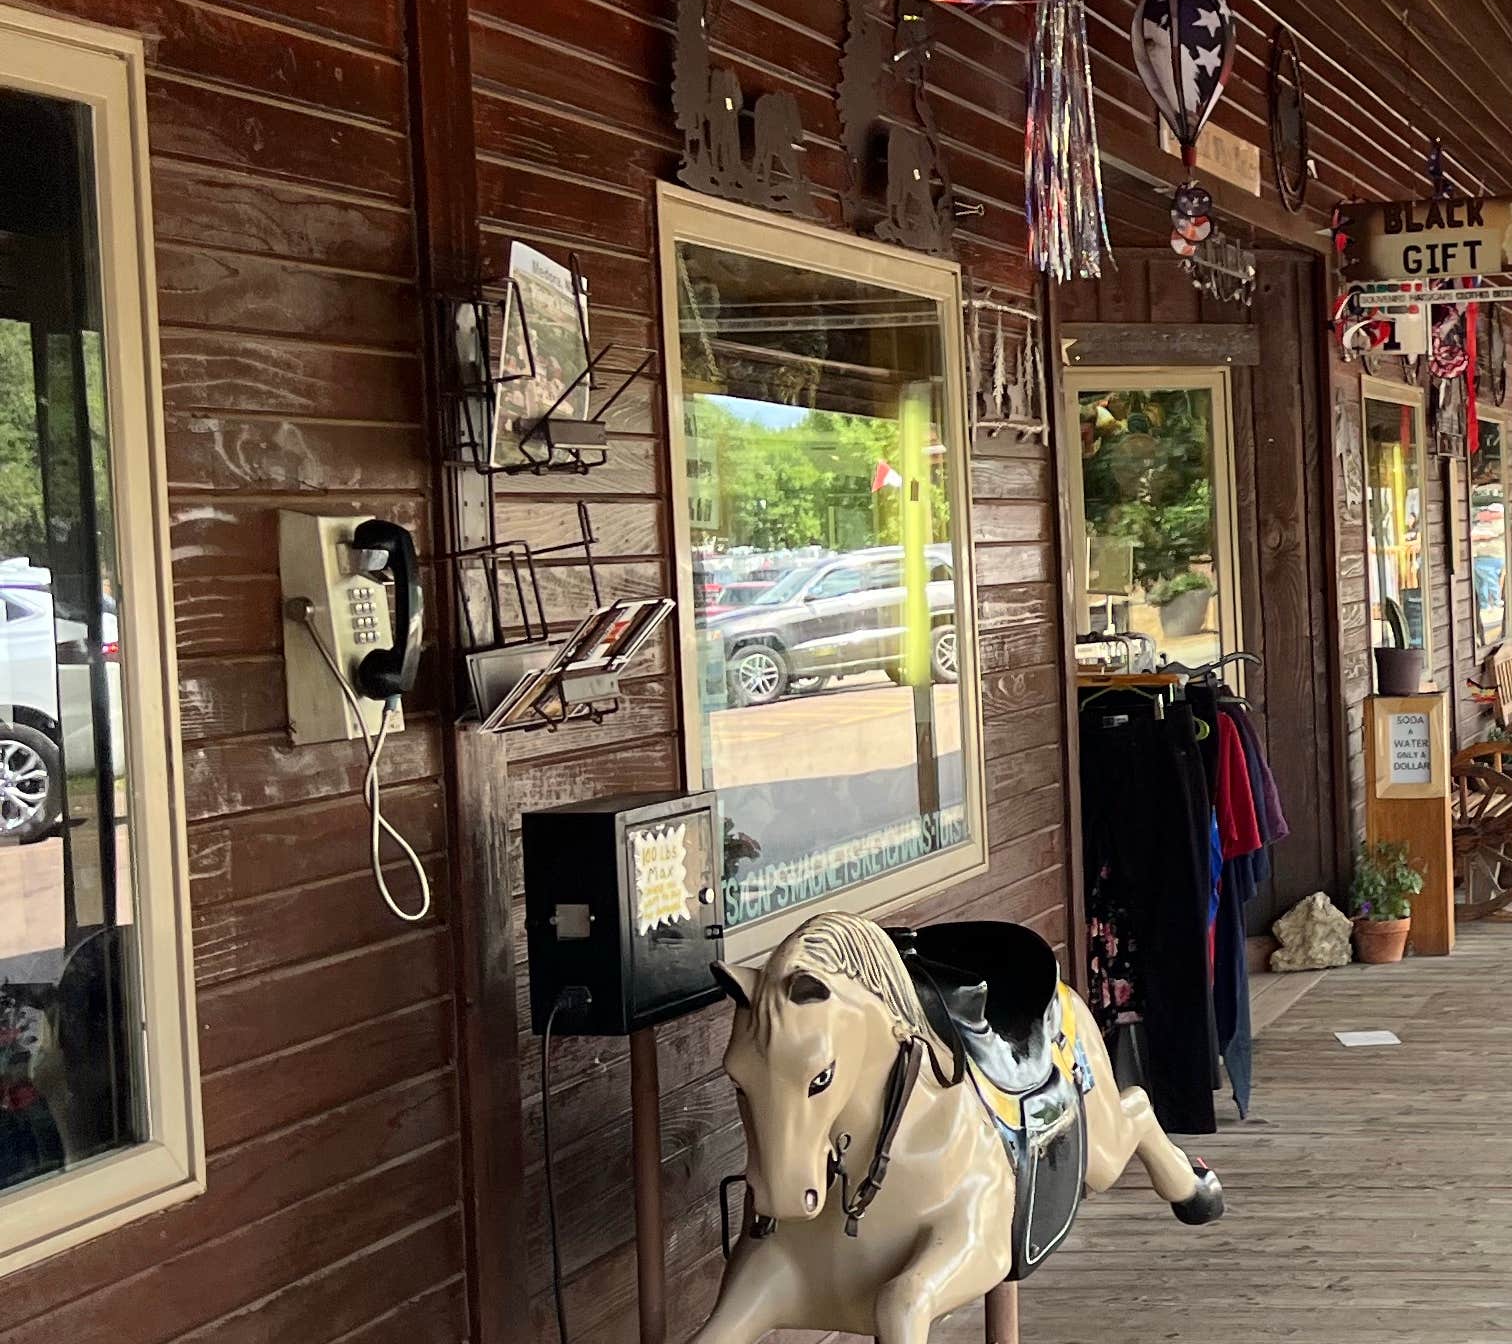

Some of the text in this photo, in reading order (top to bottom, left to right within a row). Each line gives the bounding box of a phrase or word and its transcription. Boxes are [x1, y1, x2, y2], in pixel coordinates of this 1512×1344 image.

[1384, 199, 1484, 235] BLACK
[1402, 239, 1483, 275] GIFT
[1397, 715, 1425, 725] SODA
[1394, 739, 1429, 748] WATER
[1397, 751, 1418, 759] ONLY
[1393, 761, 1430, 771] DOLLAR
